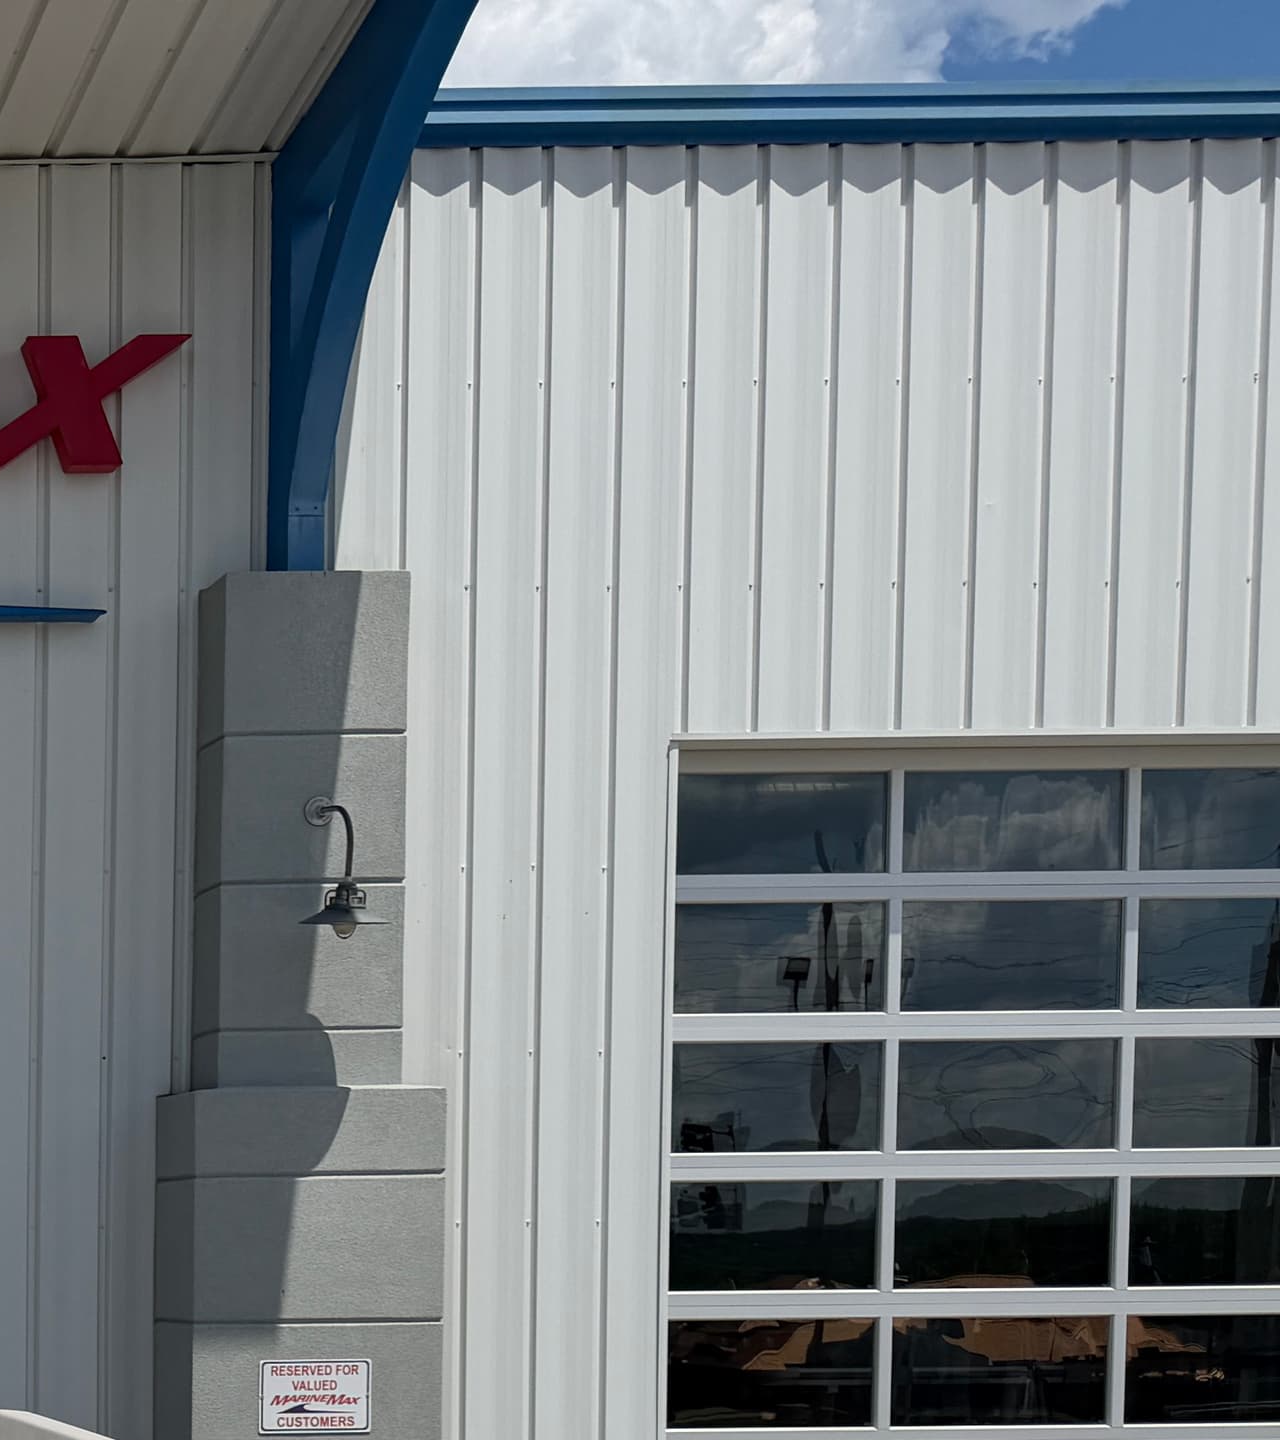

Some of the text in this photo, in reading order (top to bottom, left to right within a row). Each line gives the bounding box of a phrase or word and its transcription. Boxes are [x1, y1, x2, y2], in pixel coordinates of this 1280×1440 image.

[270, 1364, 359, 1376] RESERVED FOR
[292, 1380, 337, 1391] VALUED
[277, 1416, 355, 1427] CUSTOMERS
